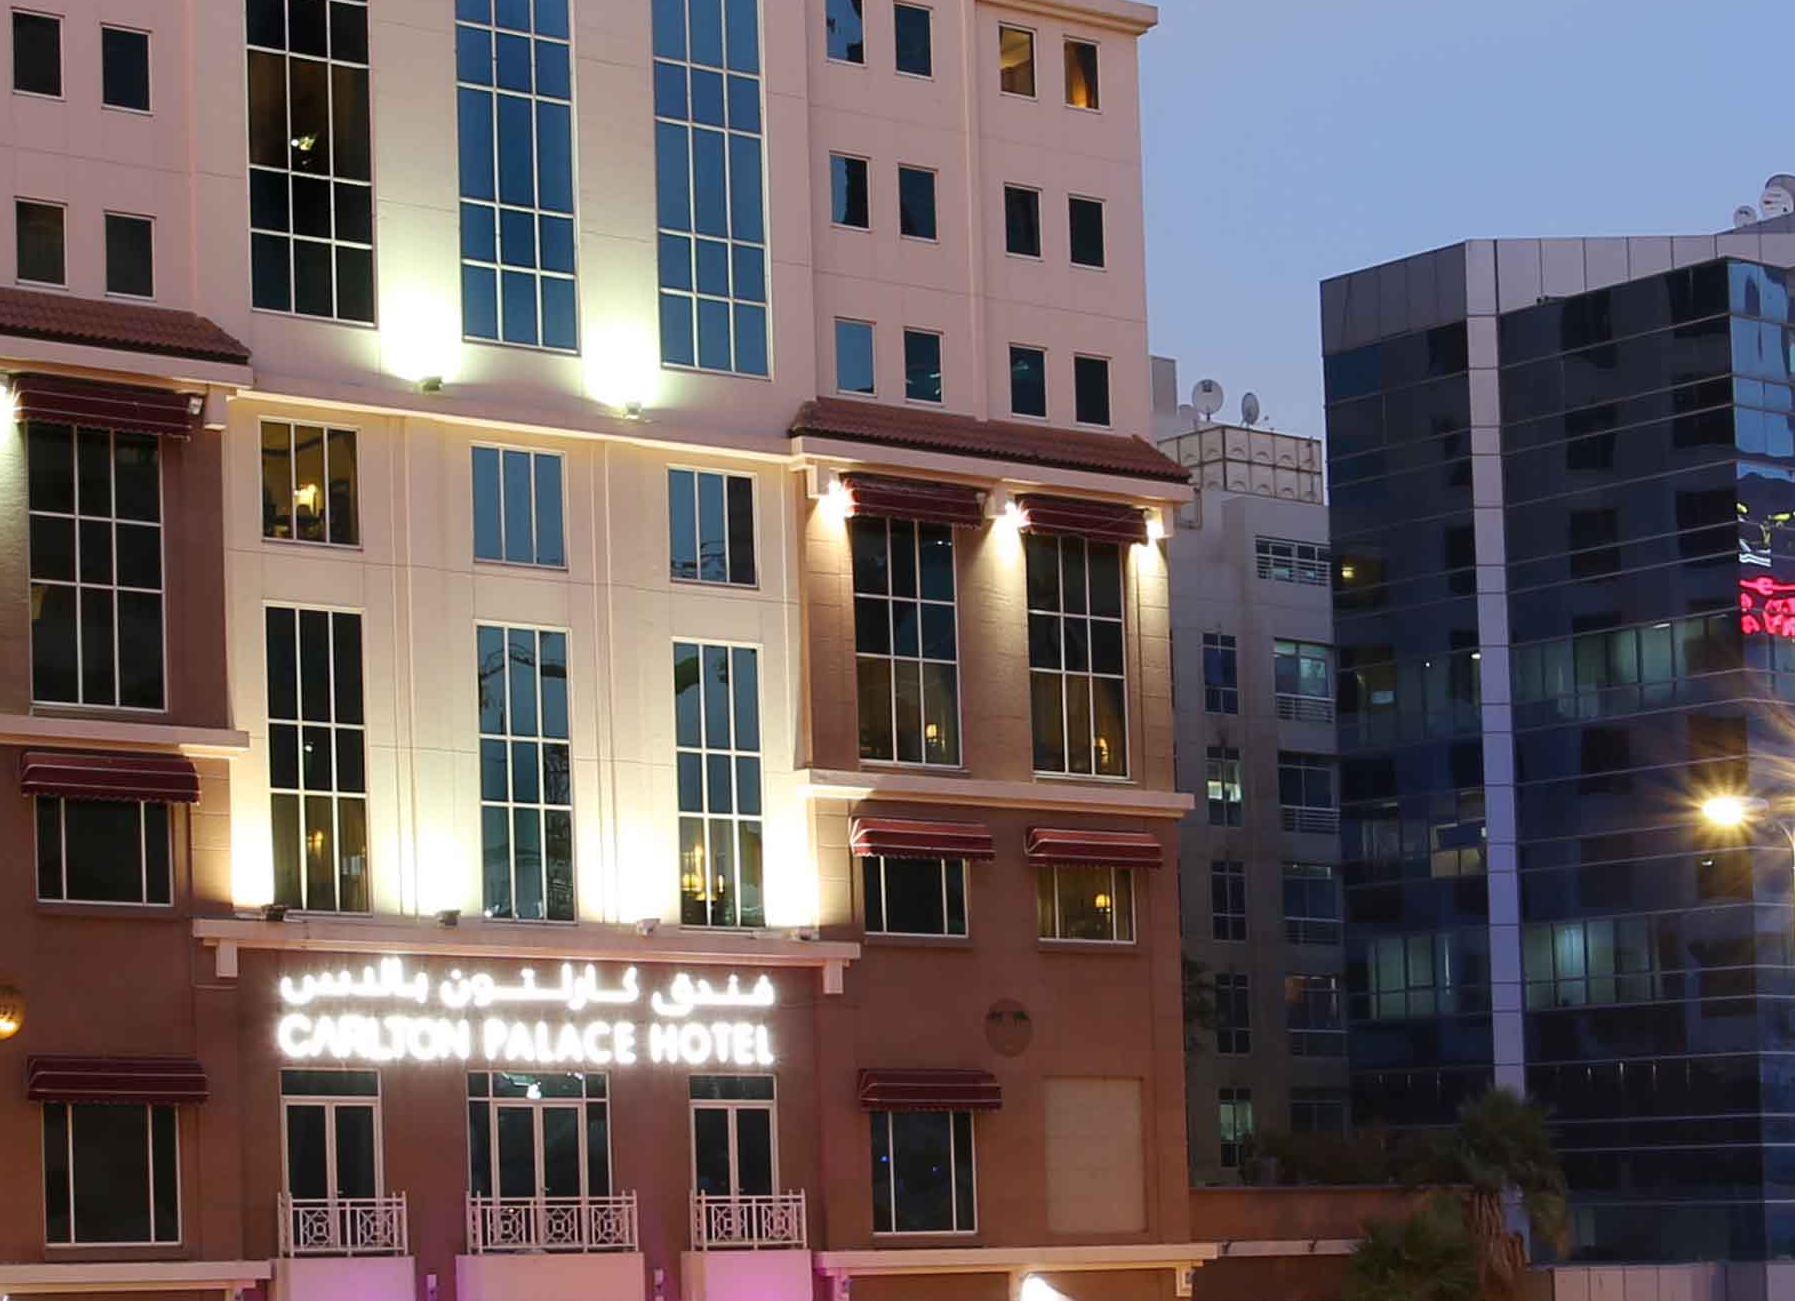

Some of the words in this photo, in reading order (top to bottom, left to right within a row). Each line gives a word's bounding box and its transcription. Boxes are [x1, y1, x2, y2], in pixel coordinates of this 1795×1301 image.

[439, 962, 640, 1012] كارلتون
[650, 971, 776, 1017] فندق
[277, 1013, 471, 1063] CARLTON
[482, 1018, 638, 1067] PALACE
[648, 1020, 776, 1067] HOTEL
